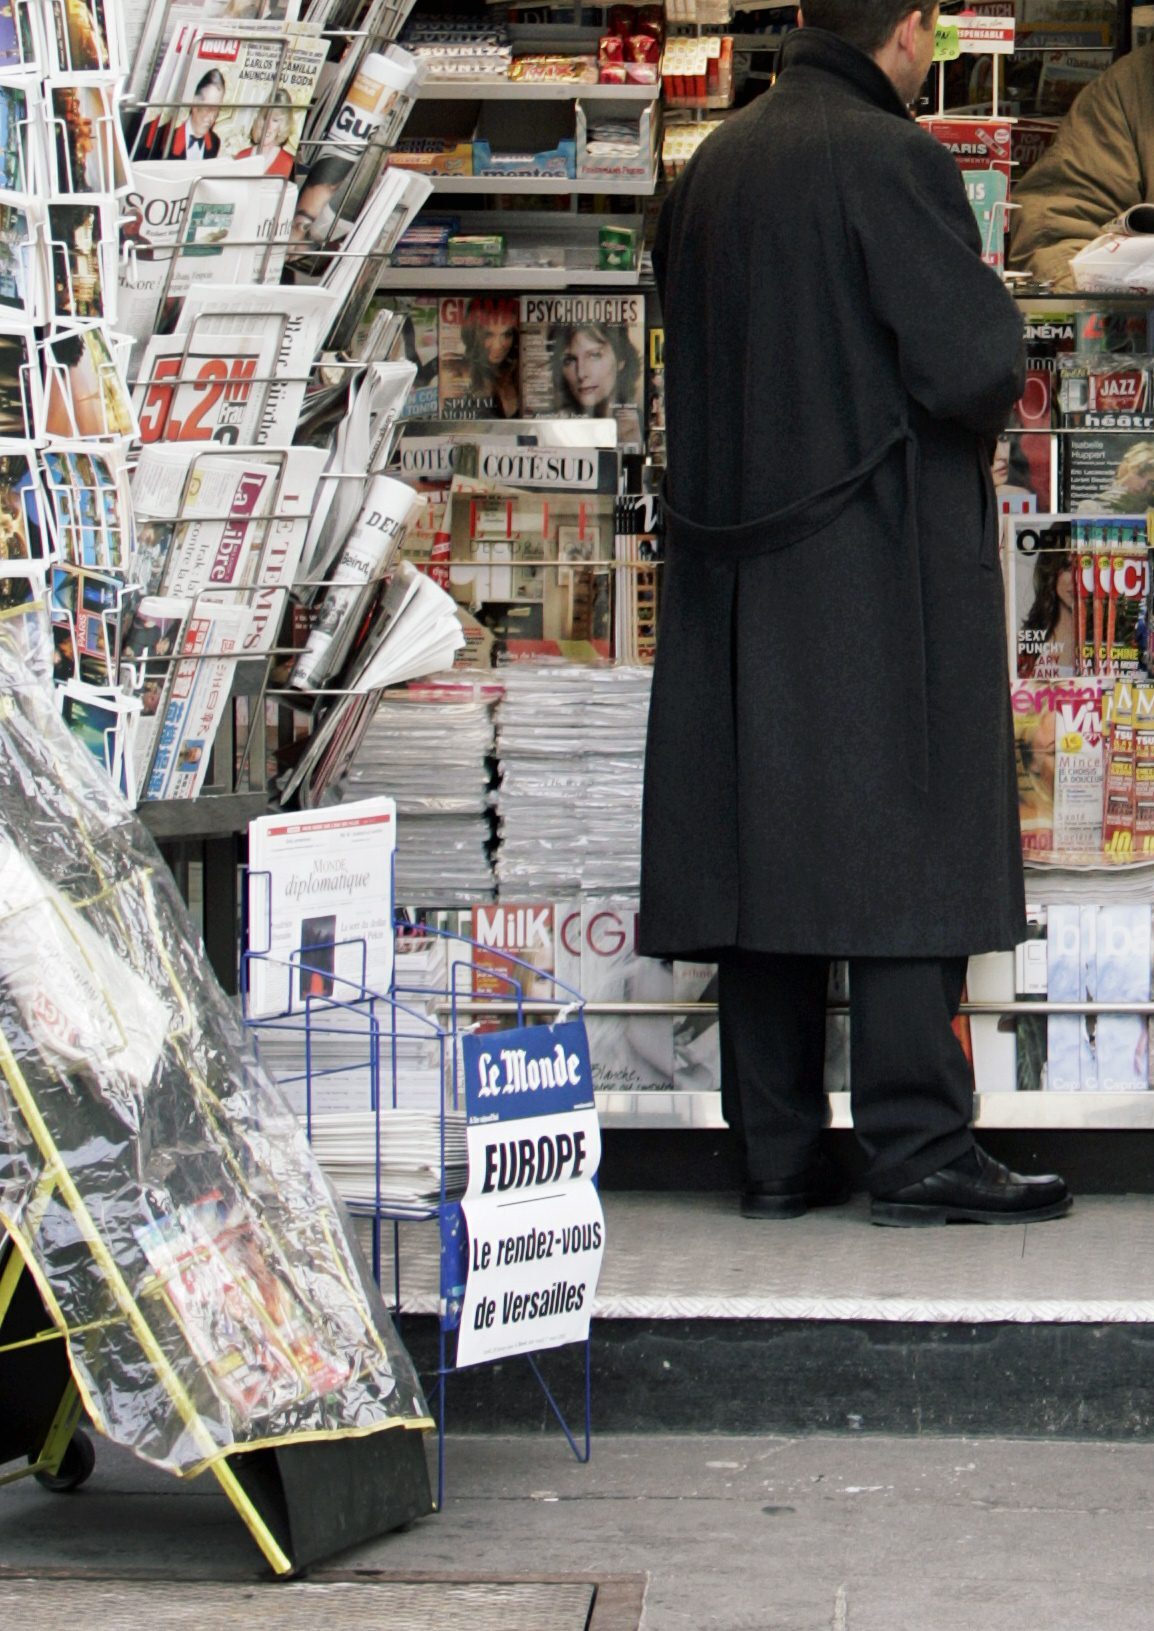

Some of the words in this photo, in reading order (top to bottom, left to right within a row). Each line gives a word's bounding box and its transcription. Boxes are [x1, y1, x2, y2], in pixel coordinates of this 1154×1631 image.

[972, 3, 1012, 17] MATCH
[244, 57, 273, 70] CARLOS
[281, 61, 318, 74] CAMILLA
[525, 298, 639, 323] PSYCHOLOGIES
[1100, 378, 1136, 396] JAZZ
[1071, 440, 1104, 450] Isabelle
[1071, 450, 1106, 461] Huppert
[545, 454, 595, 483] SUD
[233, 476, 263, 507] La
[242, 542, 290, 650] TEMPS
[1017, 629, 1048, 643] SEXY
[1017, 642, 1065, 656] PUNCHY
[1109, 647, 1139, 661] CHINE
[1058, 756, 1100, 768] Mince
[285, 872, 371, 902] diplomatique
[476, 908, 551, 949] MilK
[478, 1052, 501, 1098] Le
[502, 1044, 582, 1094] Monde
[481, 1131, 586, 1194] EUROPE
[473, 1236, 492, 1271] Le
[496, 1220, 602, 1266] rendez-vous
[473, 1293, 495, 1330] de
[502, 1281, 586, 1325] Versailles
